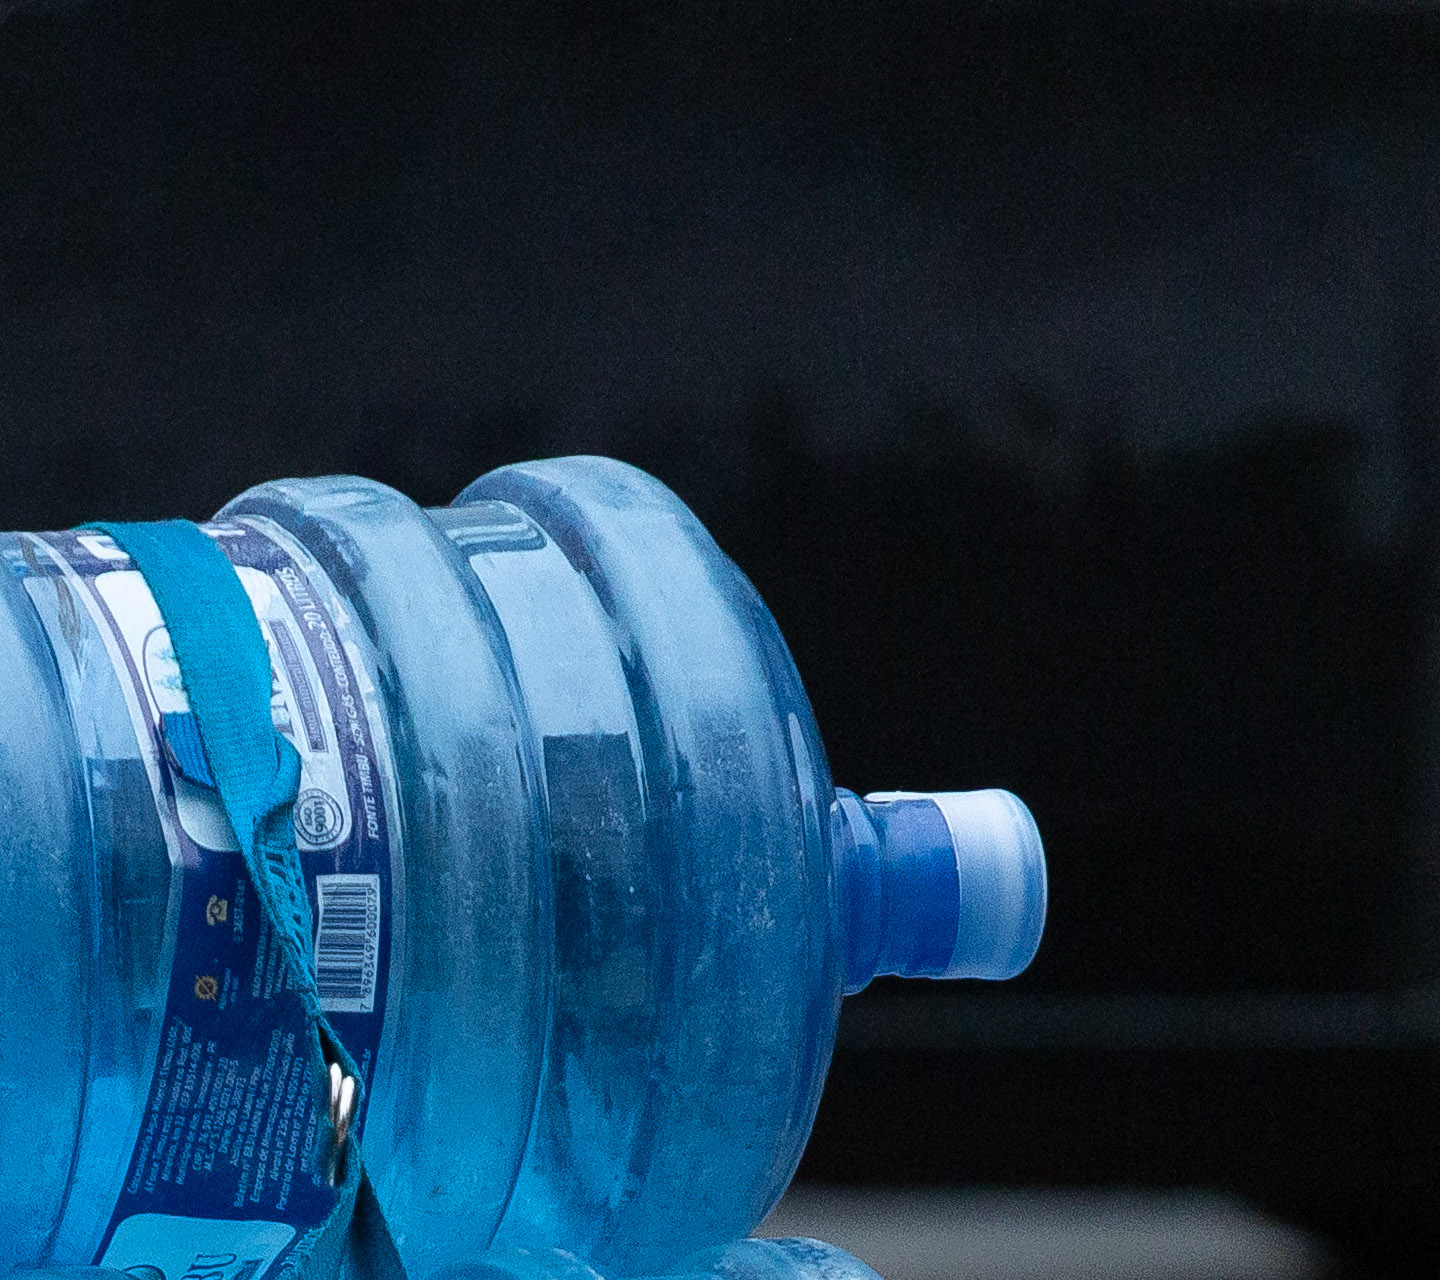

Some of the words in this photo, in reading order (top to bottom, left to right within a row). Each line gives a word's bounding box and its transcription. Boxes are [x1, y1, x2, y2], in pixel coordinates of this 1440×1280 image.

[274, 566, 317, 610] LITROS
[306, 611, 326, 630] 20
[351, 720, 366, 746] SEM
[355, 753, 374, 794] TIMBU
[304, 806, 312, 825] ISO
[313, 800, 327, 832] 9001
[364, 796, 380, 839] FONTE
